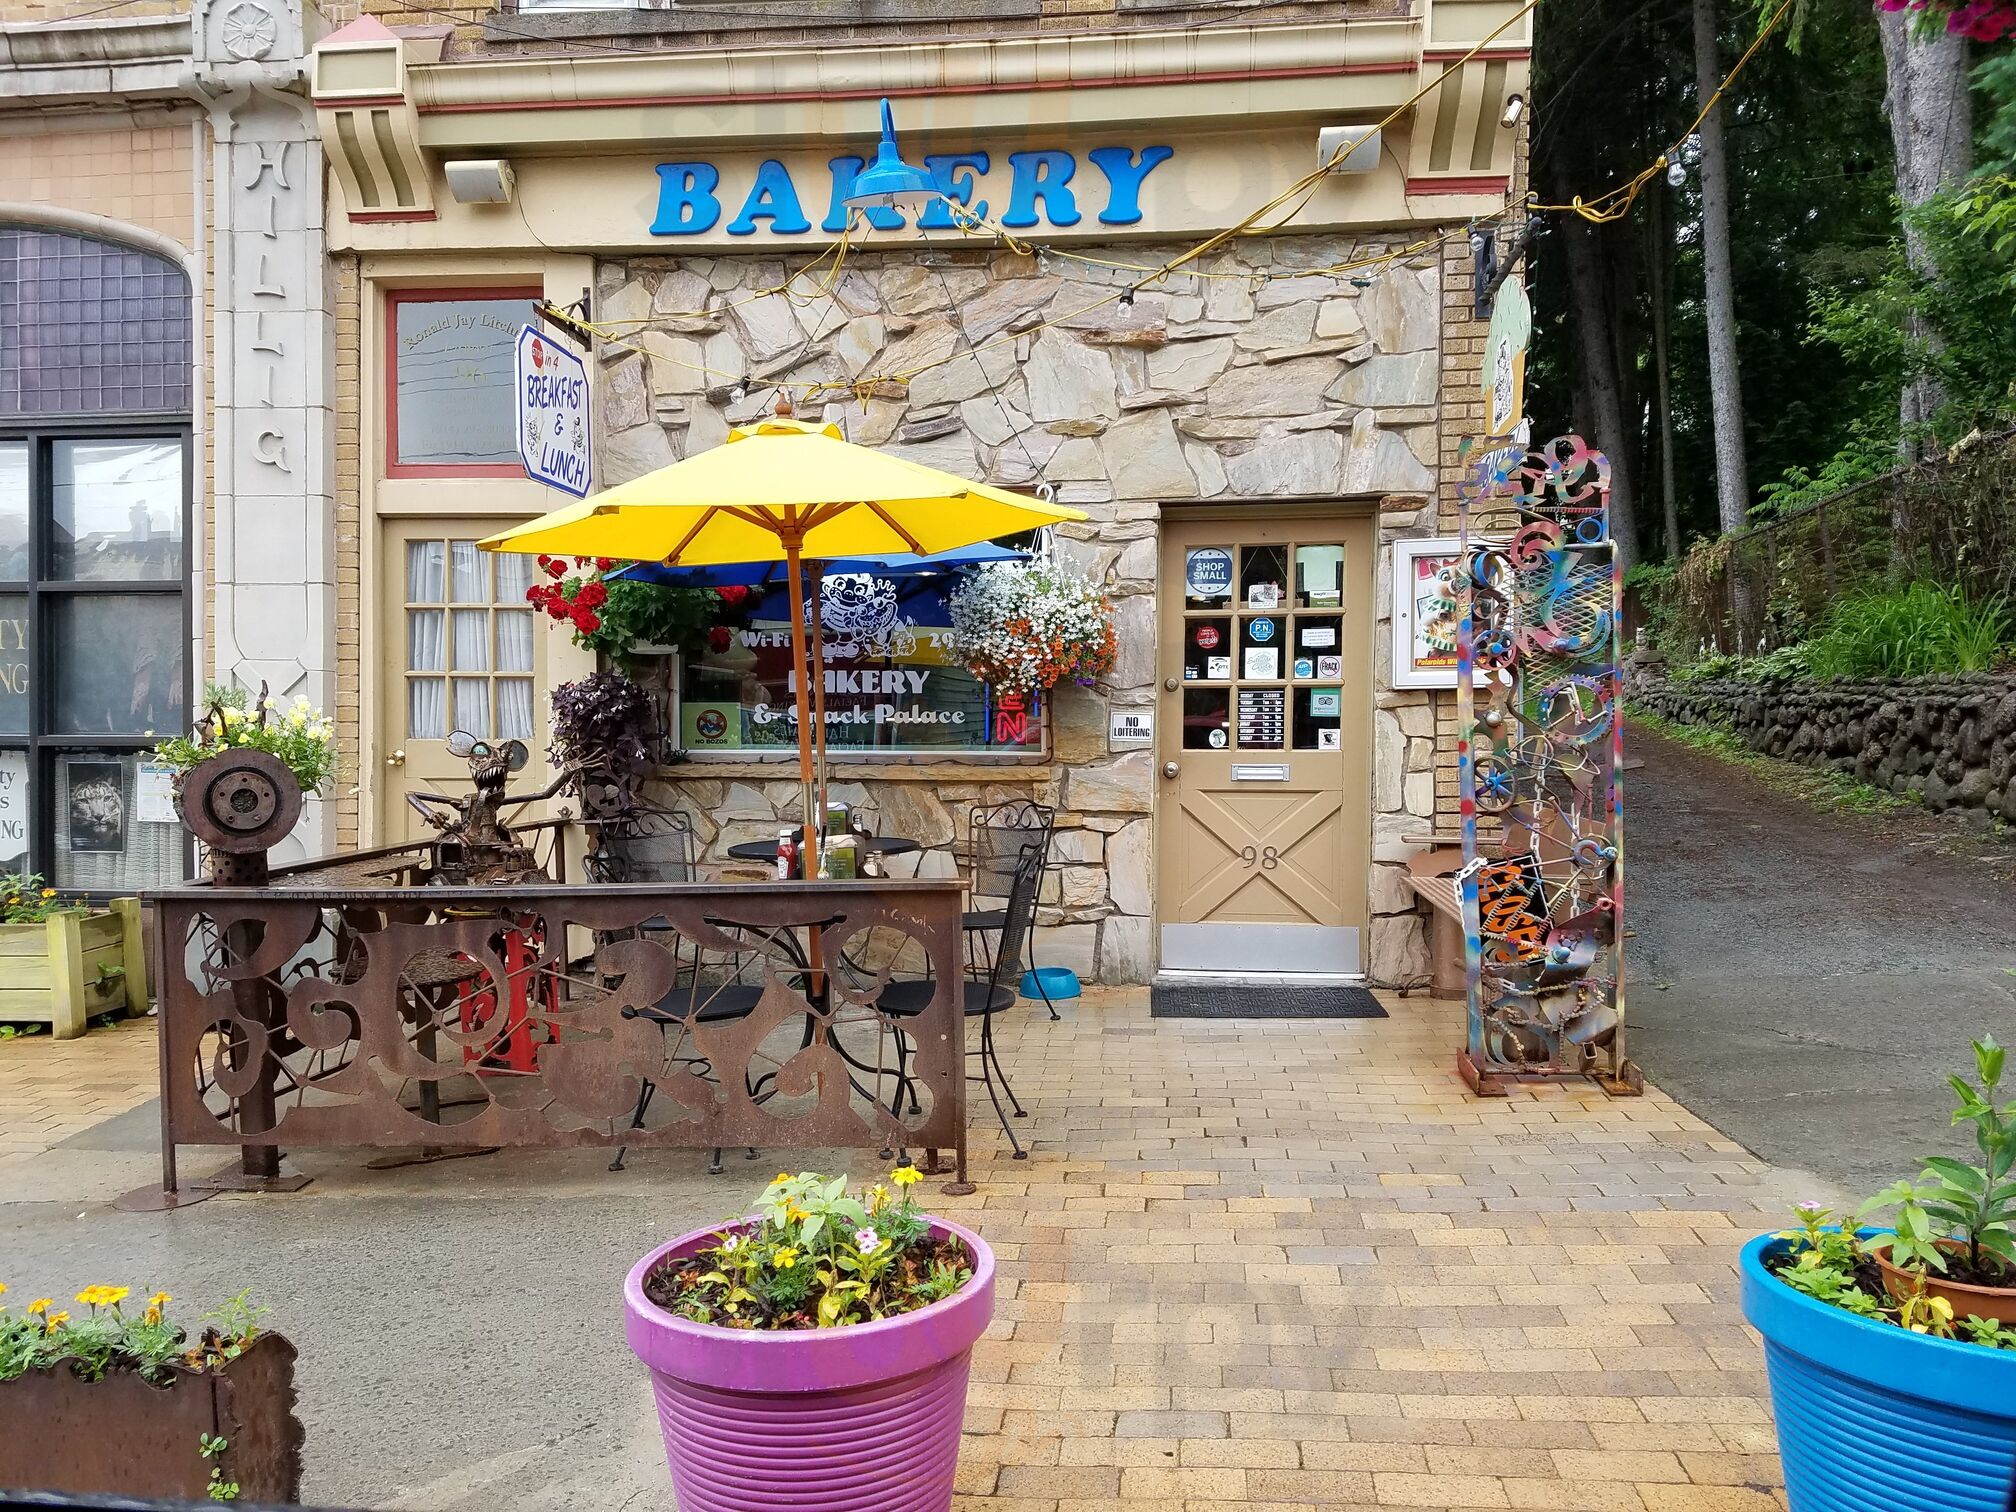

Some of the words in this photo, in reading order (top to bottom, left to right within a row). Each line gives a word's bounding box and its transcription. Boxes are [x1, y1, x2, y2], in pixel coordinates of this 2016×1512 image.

[648, 145, 1175, 237] BAKERY
[404, 317, 451, 350] Ronald
[453, 313, 476, 329] Jay
[545, 351, 552, 367] in
[527, 374, 583, 410] BREAKFAST
[554, 413, 564, 436] &
[540, 442, 585, 488] LUNCH
[1193, 571, 1227, 580] SMALL
[1196, 562, 1225, 572] SHOP
[740, 631, 791, 648] Wi-Fi
[1416, 658, 1446, 666] Polaroids
[788, 670, 931, 694] BAKERY
[753, 704, 778, 725] &
[874, 704, 966, 724] Palace
[1125, 716, 1139, 727] NO
[1113, 727, 1150, 737] LOITERING
[1240, 844, 1279, 871] 98
